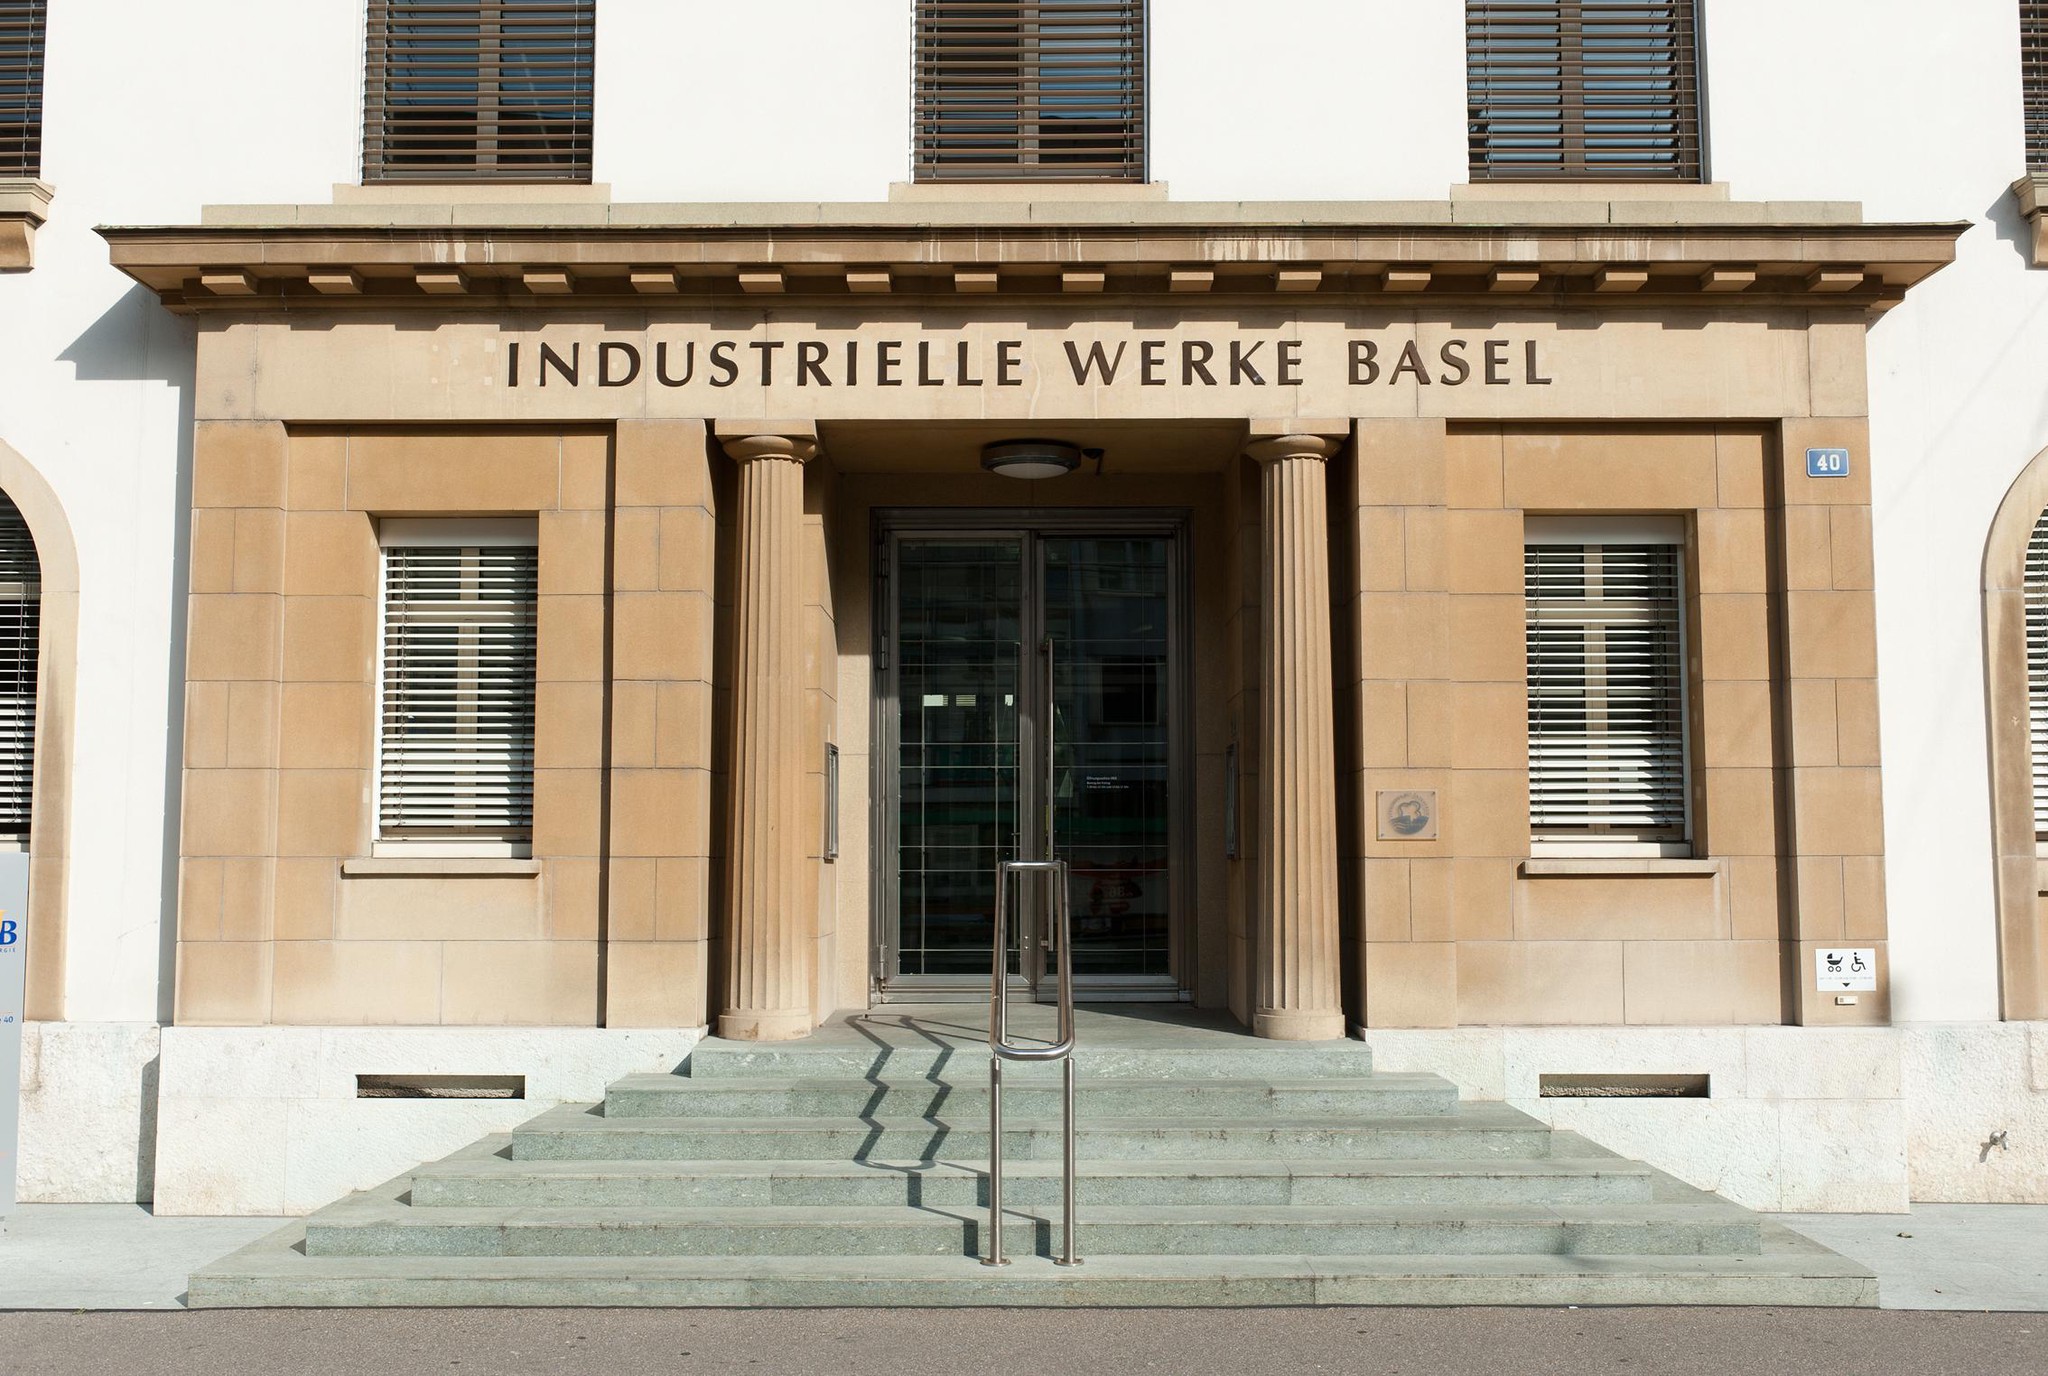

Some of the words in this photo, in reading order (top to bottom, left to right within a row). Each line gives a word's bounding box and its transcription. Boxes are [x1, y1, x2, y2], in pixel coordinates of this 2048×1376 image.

[507, 340, 1023, 388] INDUSTRIELLE
[1063, 339, 1304, 387] WERKE
[1347, 339, 1553, 387] BASEL
[1816, 454, 1841, 472] 40
